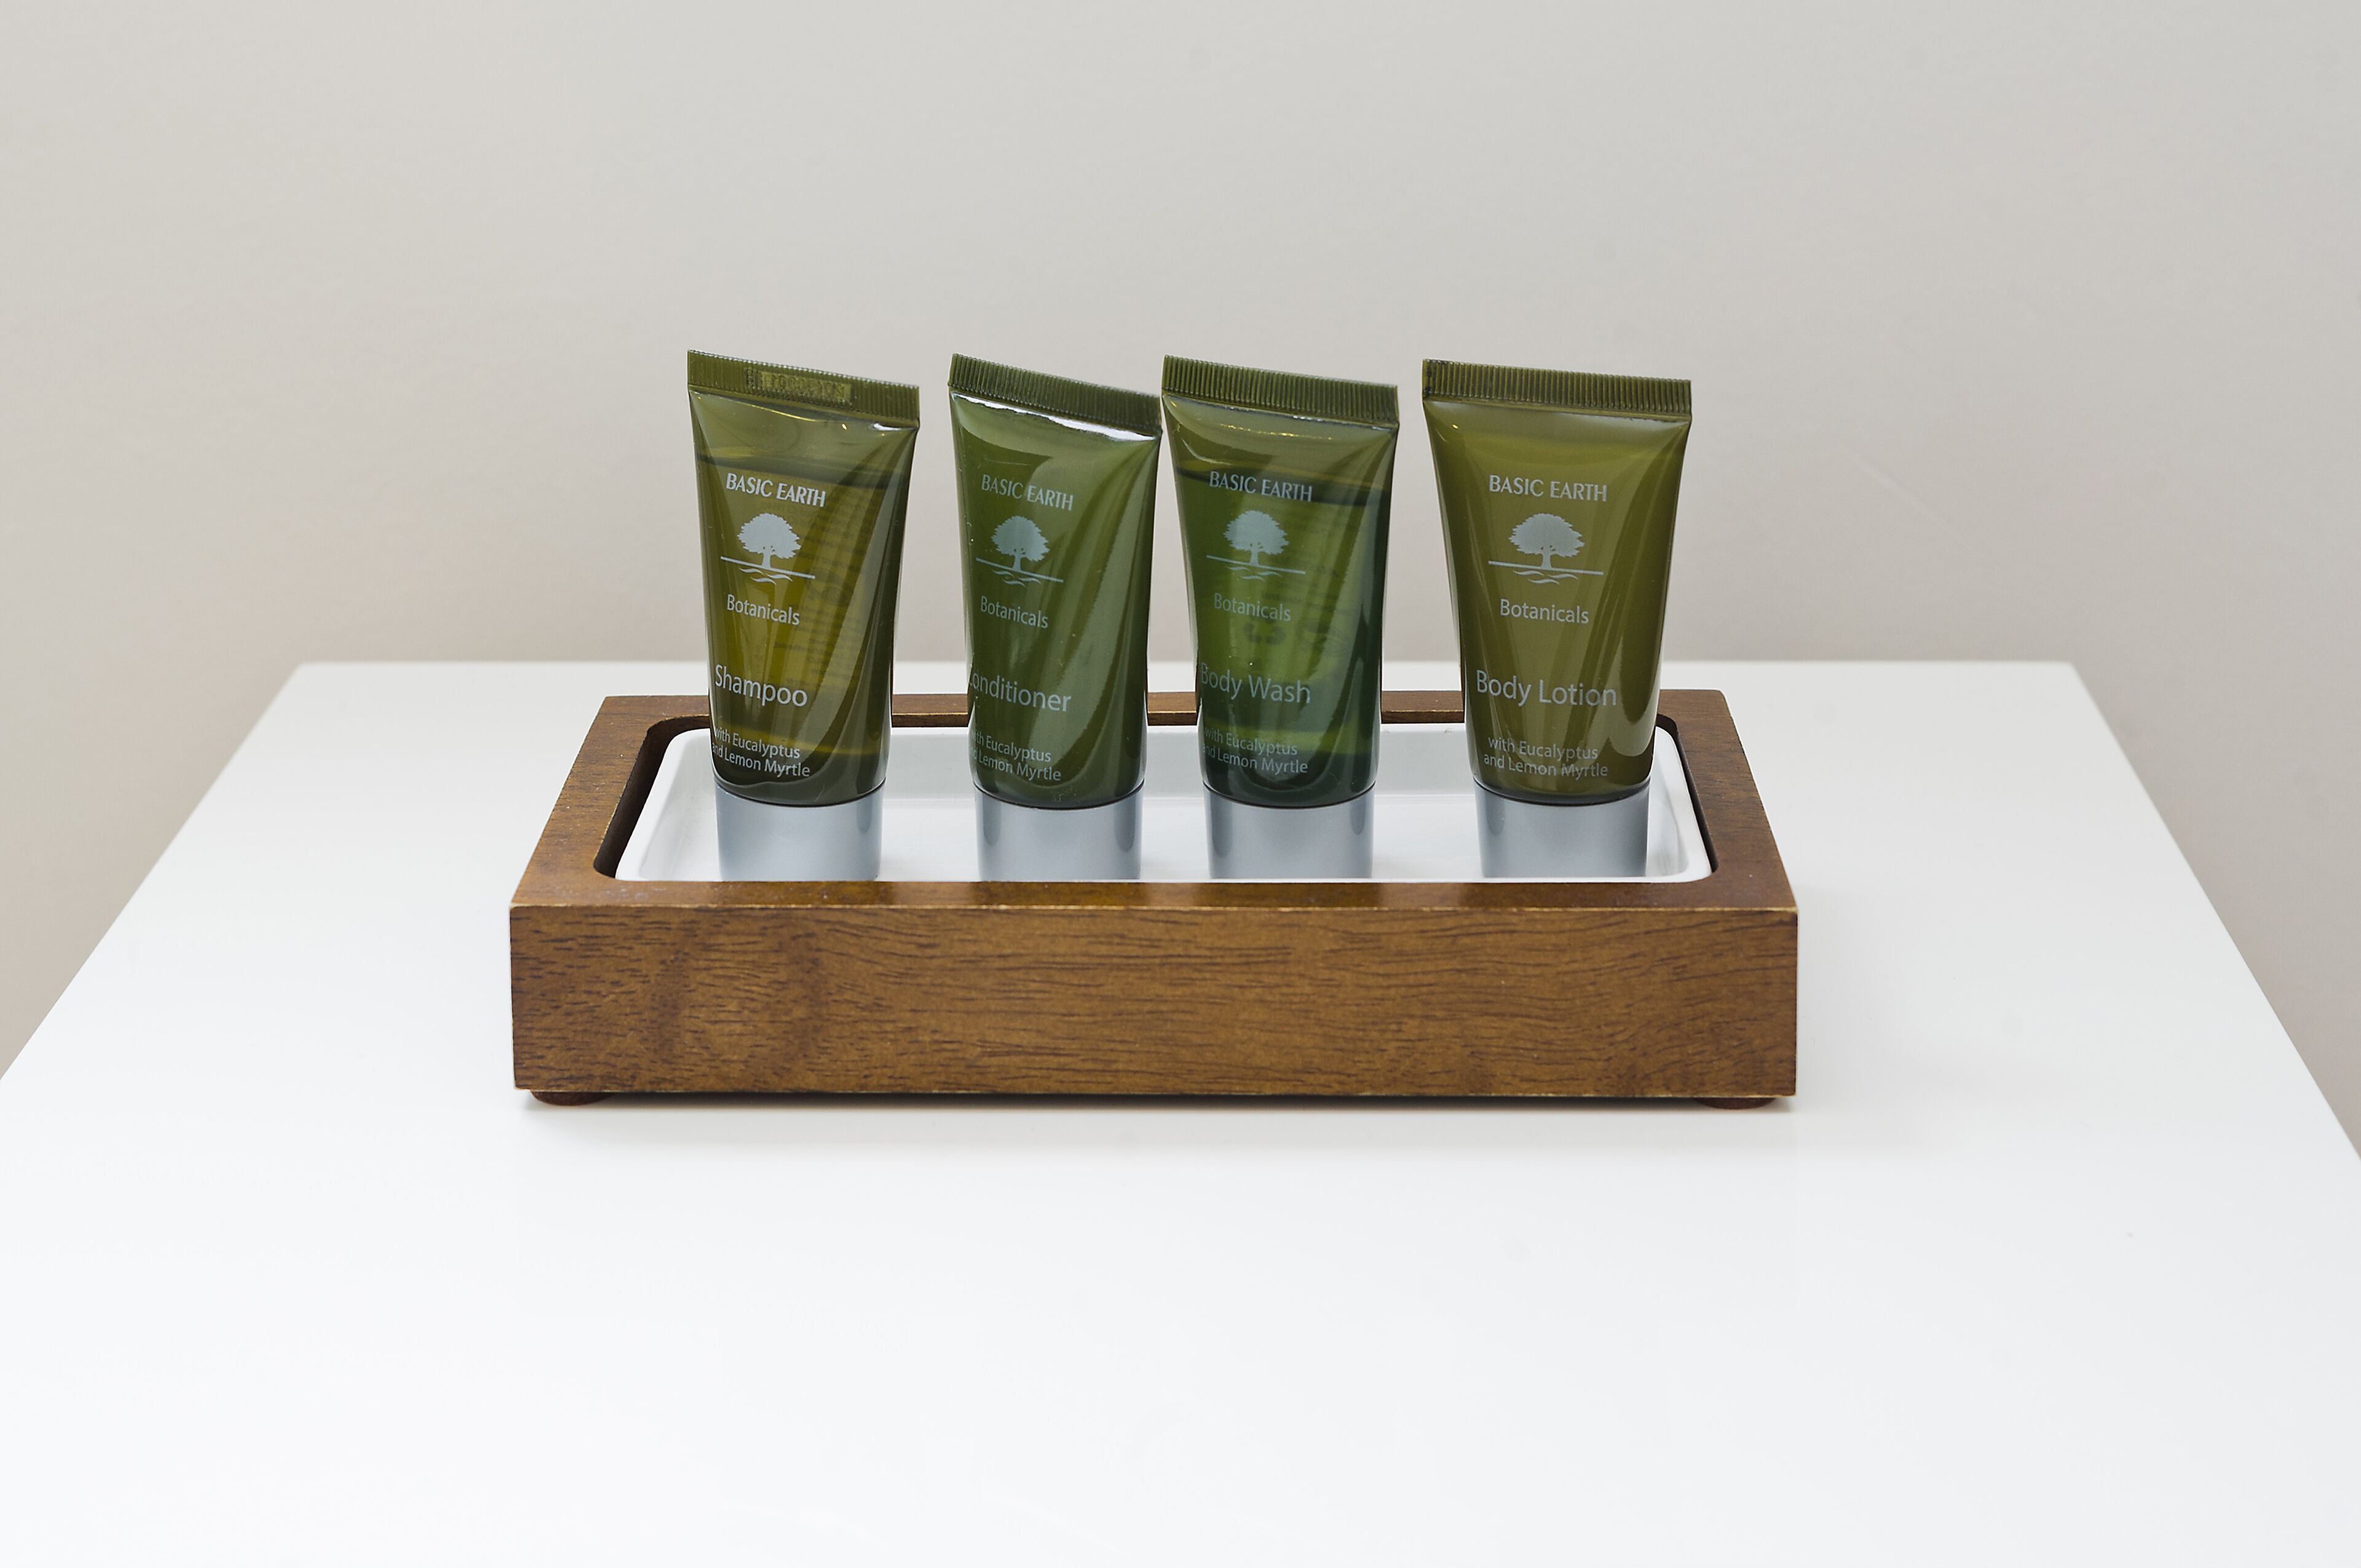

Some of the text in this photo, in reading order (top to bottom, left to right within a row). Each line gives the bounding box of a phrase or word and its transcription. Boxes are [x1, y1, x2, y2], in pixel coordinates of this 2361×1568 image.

[726, 473, 826, 507] BASIC EARTH
[981, 473, 1074, 511] BASIC EARTH
[1209, 471, 1313, 502] BASIC EARTH
[1489, 474, 1607, 502] BASIC EARTH
[727, 594, 800, 625] Botanicals
[981, 596, 1048, 628] Botanicals
[1214, 593, 1291, 622] Botanicals
[1500, 598, 1589, 624] Botanicals
[715, 663, 808, 707] Shampoo
[970, 673, 1072, 712] onditioner
[1200, 662, 1311, 704] Body Wash
[1476, 669, 1617, 707] Body Lotion
[733, 732, 801, 759] Eucalyptus
[986, 735, 1051, 763] Eucalyptus
[1204, 727, 1298, 756] with Eucalyptus
[1488, 737, 1598, 762] with Eucalyptus
[724, 745, 761, 771] Lemon
[765, 761, 811, 778] Myrtle
[979, 750, 1013, 774] Lemon
[1016, 762, 1061, 782] Myrtle
[1217, 748, 1257, 769] Lemon
[1262, 757, 1308, 775] Myrtle
[1484, 753, 1608, 780] and Lemon Myrtle
